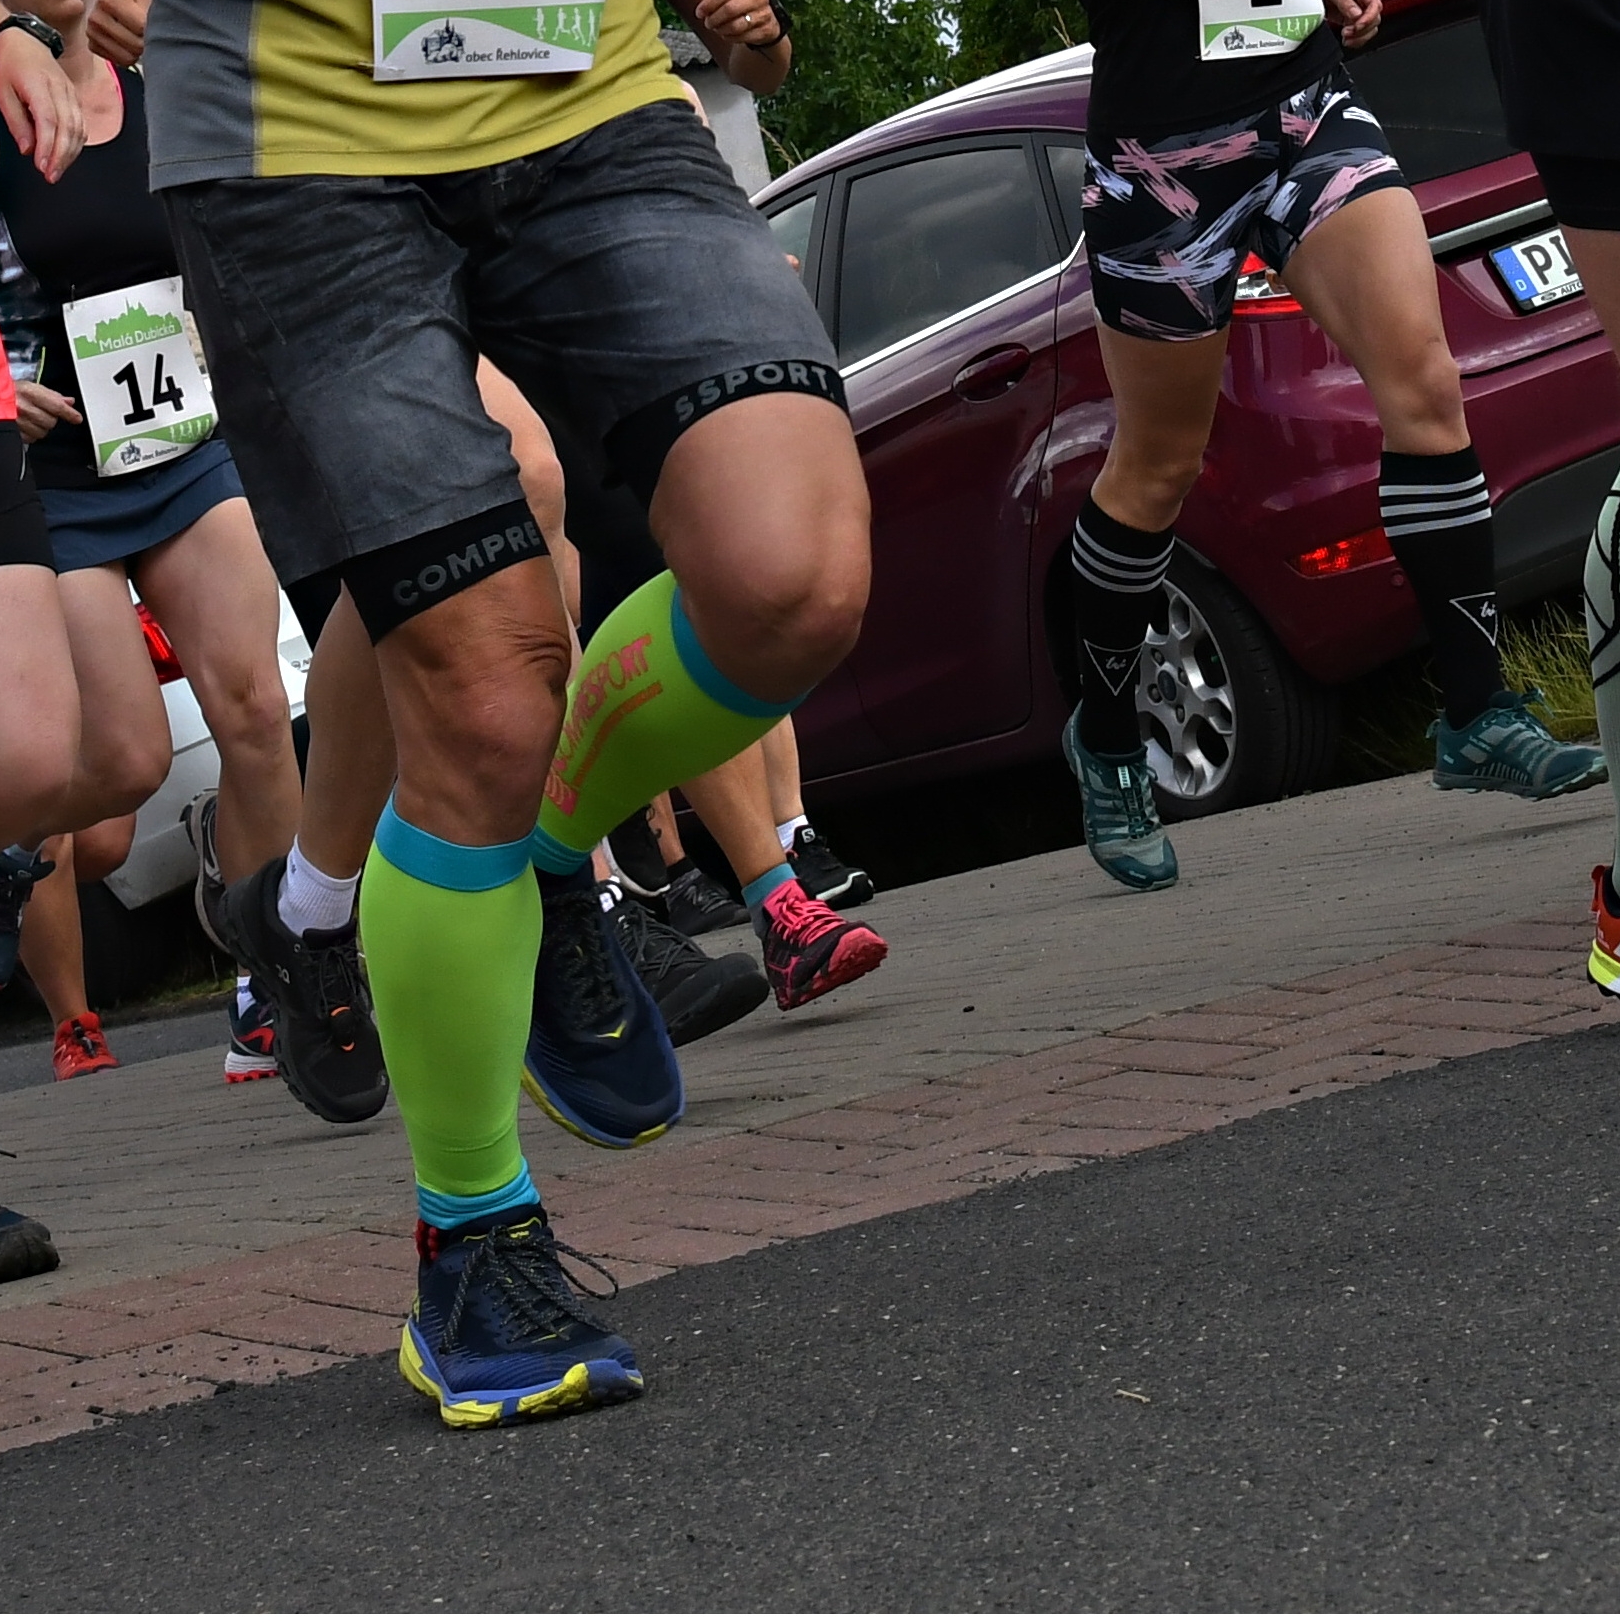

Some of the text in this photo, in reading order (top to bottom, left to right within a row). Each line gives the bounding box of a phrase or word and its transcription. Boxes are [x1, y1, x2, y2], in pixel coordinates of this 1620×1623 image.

[466, 47, 550, 63] obec Řehlovice
[99, 321, 176, 353] Malá Dubická
[112, 352, 185, 426] 14
[392, 521, 541, 607] COMPRE
